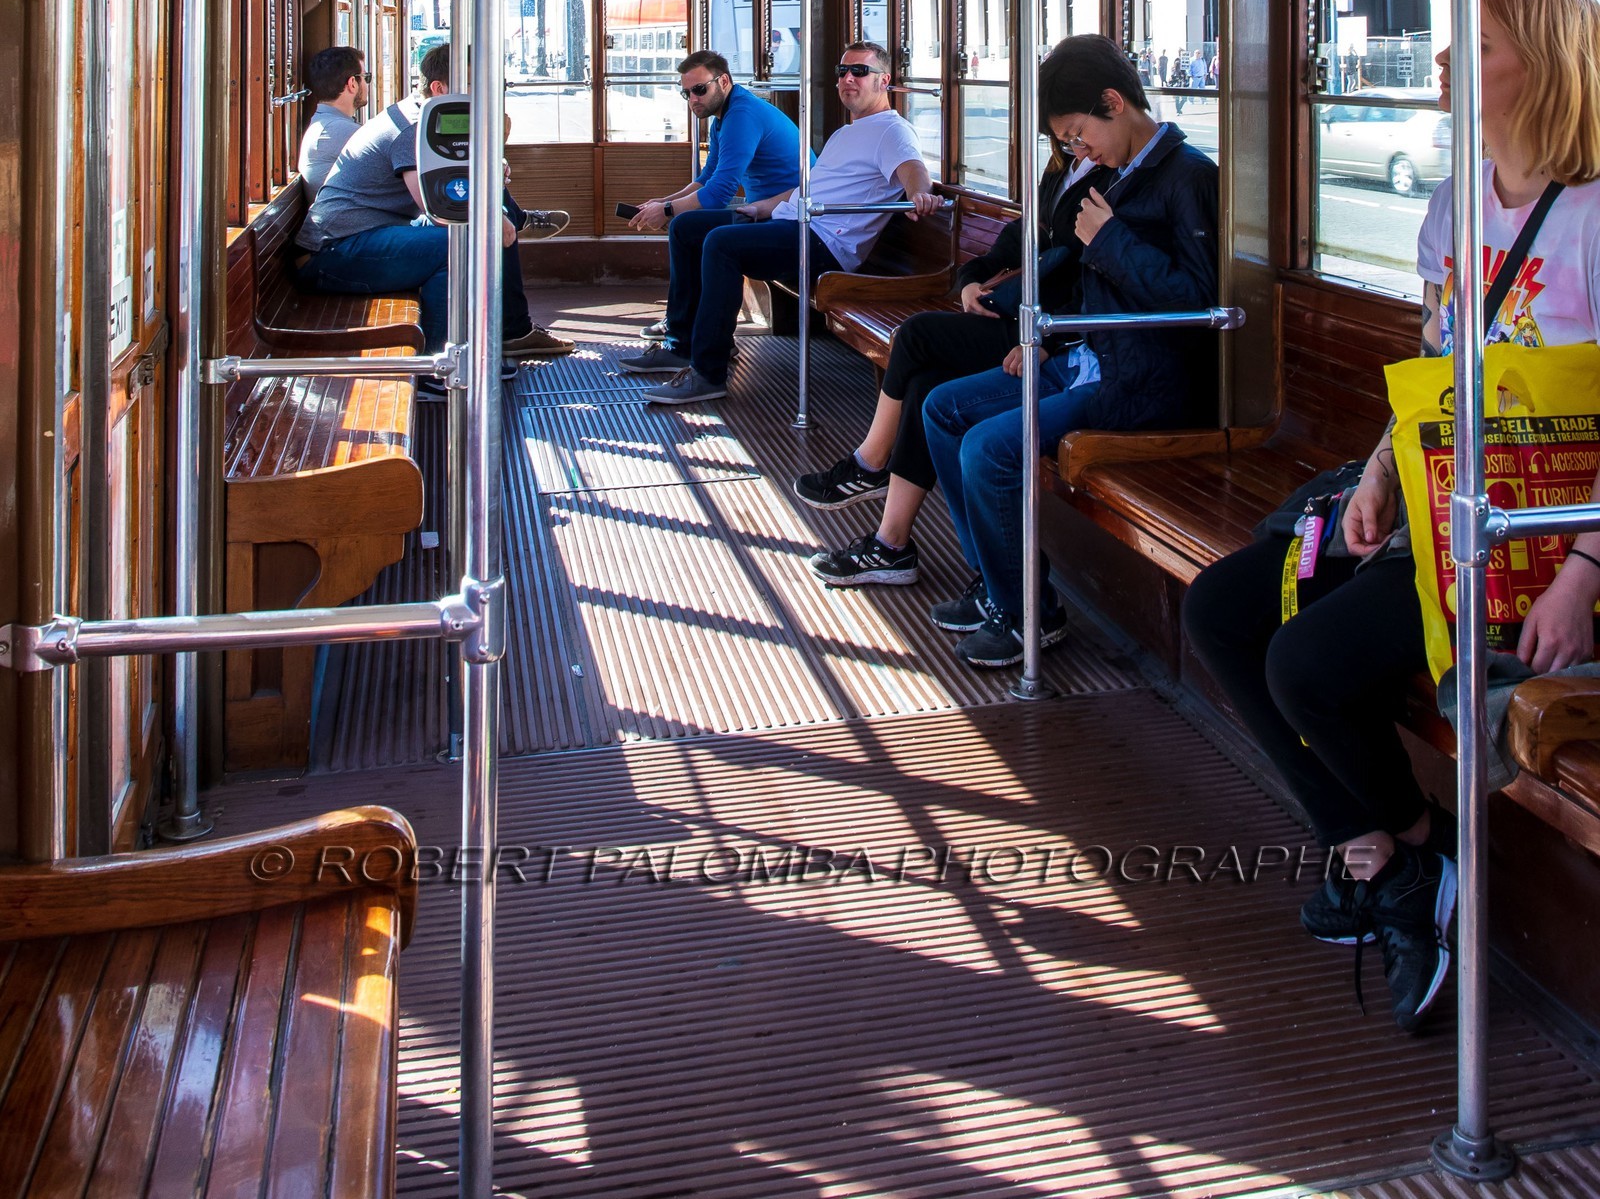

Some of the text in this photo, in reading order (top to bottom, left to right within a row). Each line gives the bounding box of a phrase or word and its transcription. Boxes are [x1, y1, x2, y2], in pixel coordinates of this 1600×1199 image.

[1501, 417, 1597, 433] SELL TRADE
[1556, 430, 1600, 443] TREASURES
